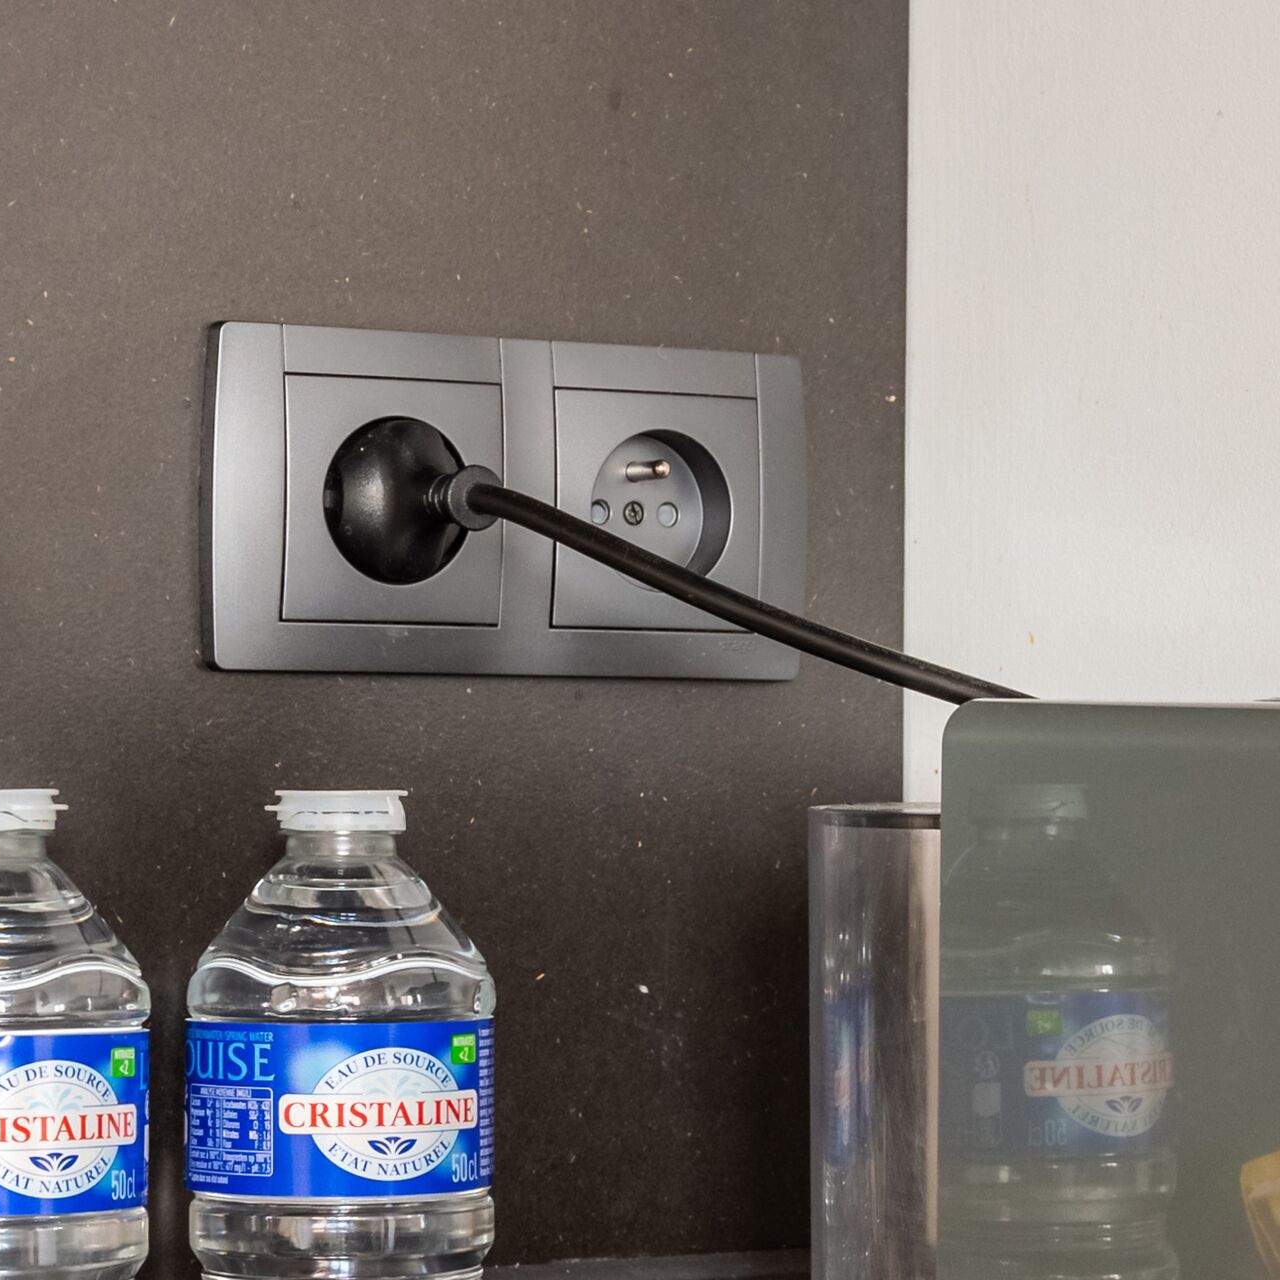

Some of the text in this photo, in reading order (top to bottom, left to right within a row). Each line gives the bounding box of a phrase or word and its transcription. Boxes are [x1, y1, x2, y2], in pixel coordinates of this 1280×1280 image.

[24, 1066, 49, 1082] DE
[53, 1064, 112, 1102] SOURCE
[324, 1051, 452, 1090] EAU DE SOURCE
[283, 1097, 475, 1130] CRISTALINE
[38, 1156, 112, 1194] NATUREL
[328, 1140, 451, 1177] ETAT NATUREL
[451, 1151, 478, 1183] 50cl
[111, 1169, 137, 1200] 50cl
